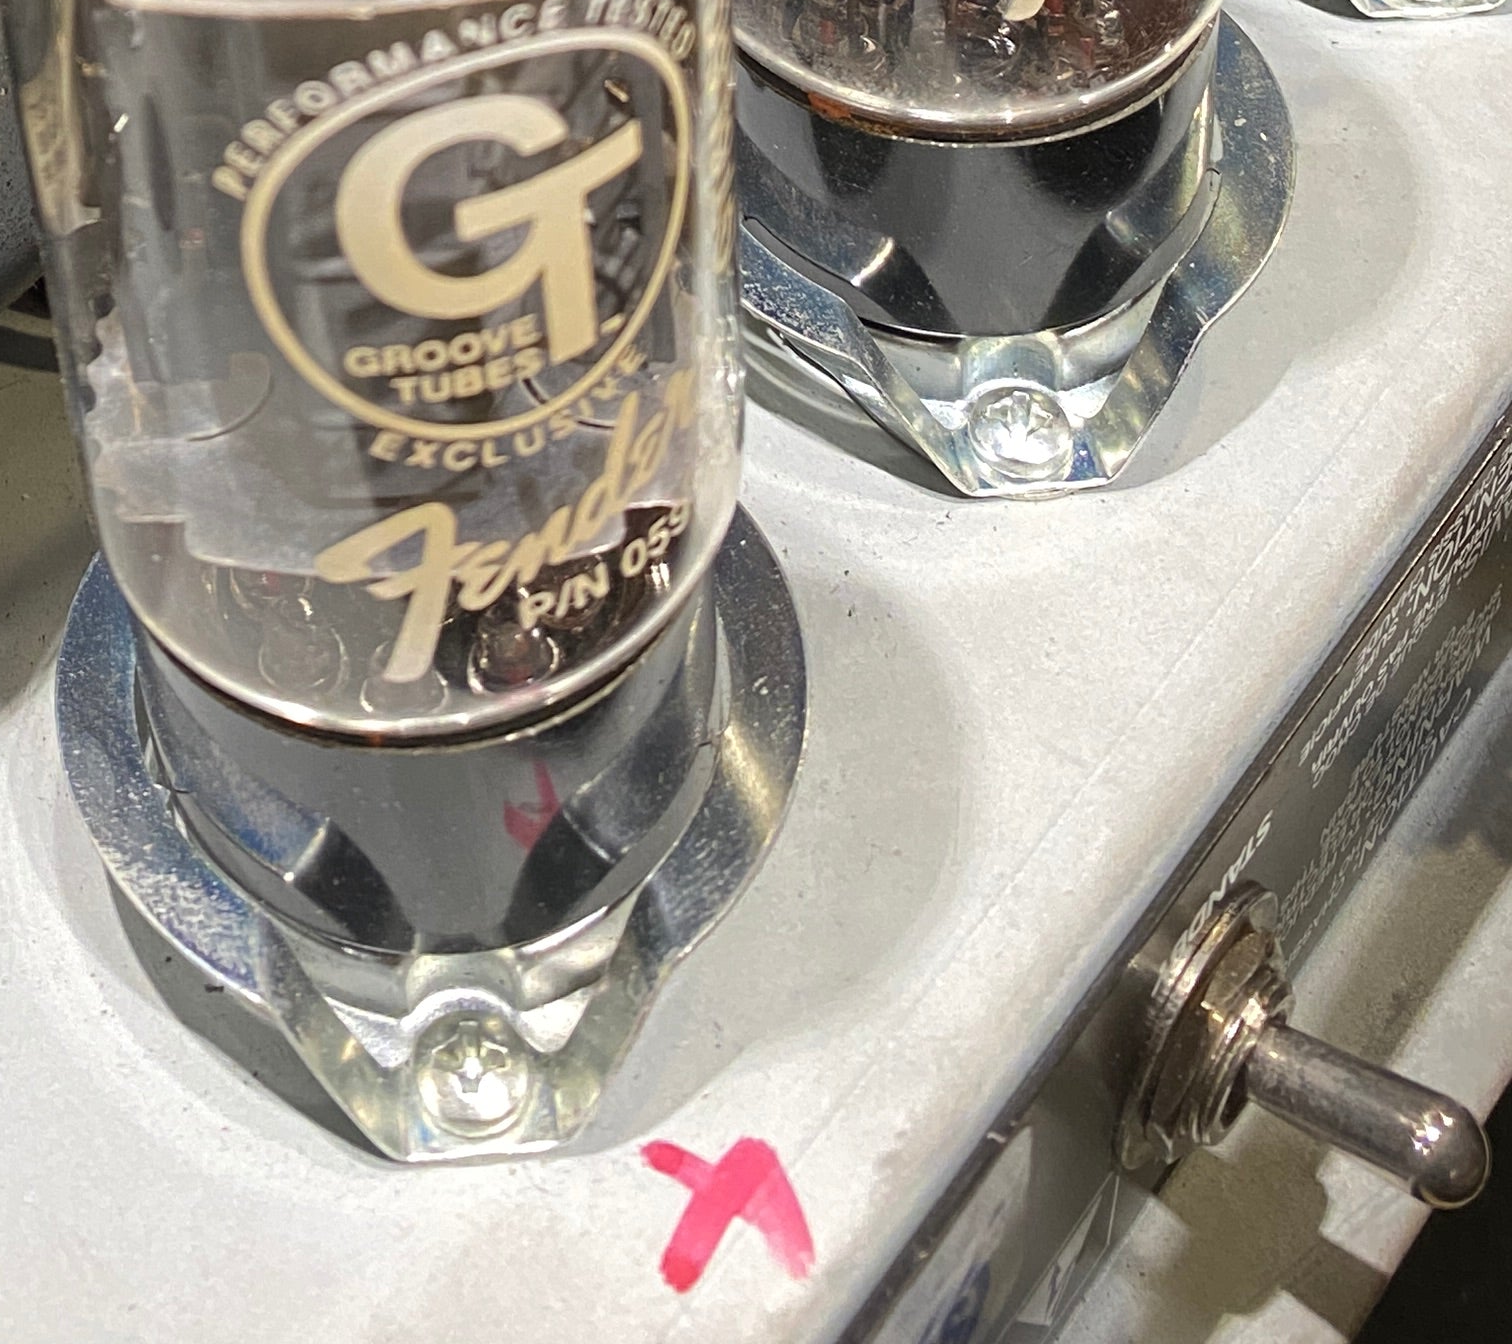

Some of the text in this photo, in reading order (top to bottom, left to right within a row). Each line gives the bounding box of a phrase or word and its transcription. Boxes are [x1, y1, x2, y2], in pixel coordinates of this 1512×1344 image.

[335, 93, 644, 363] GT
[343, 313, 543, 379] GROOVE
[390, 346, 547, 406] TUBES
[369, 341, 647, 472] EXCLUSIVE
[1427, 458, 1496, 571] CHASSIS
[518, 560, 611, 632] P/N
[1297, 453, 1512, 771] ENTION: SUPERFICIE
[1355, 559, 1425, 674] CHAUDE
[1310, 675, 1374, 780] OUVRIR
[1352, 683, 1471, 876] CAUTION:
[1365, 621, 1491, 824] WARNING:
[1280, 850, 1336, 944] REDUC
